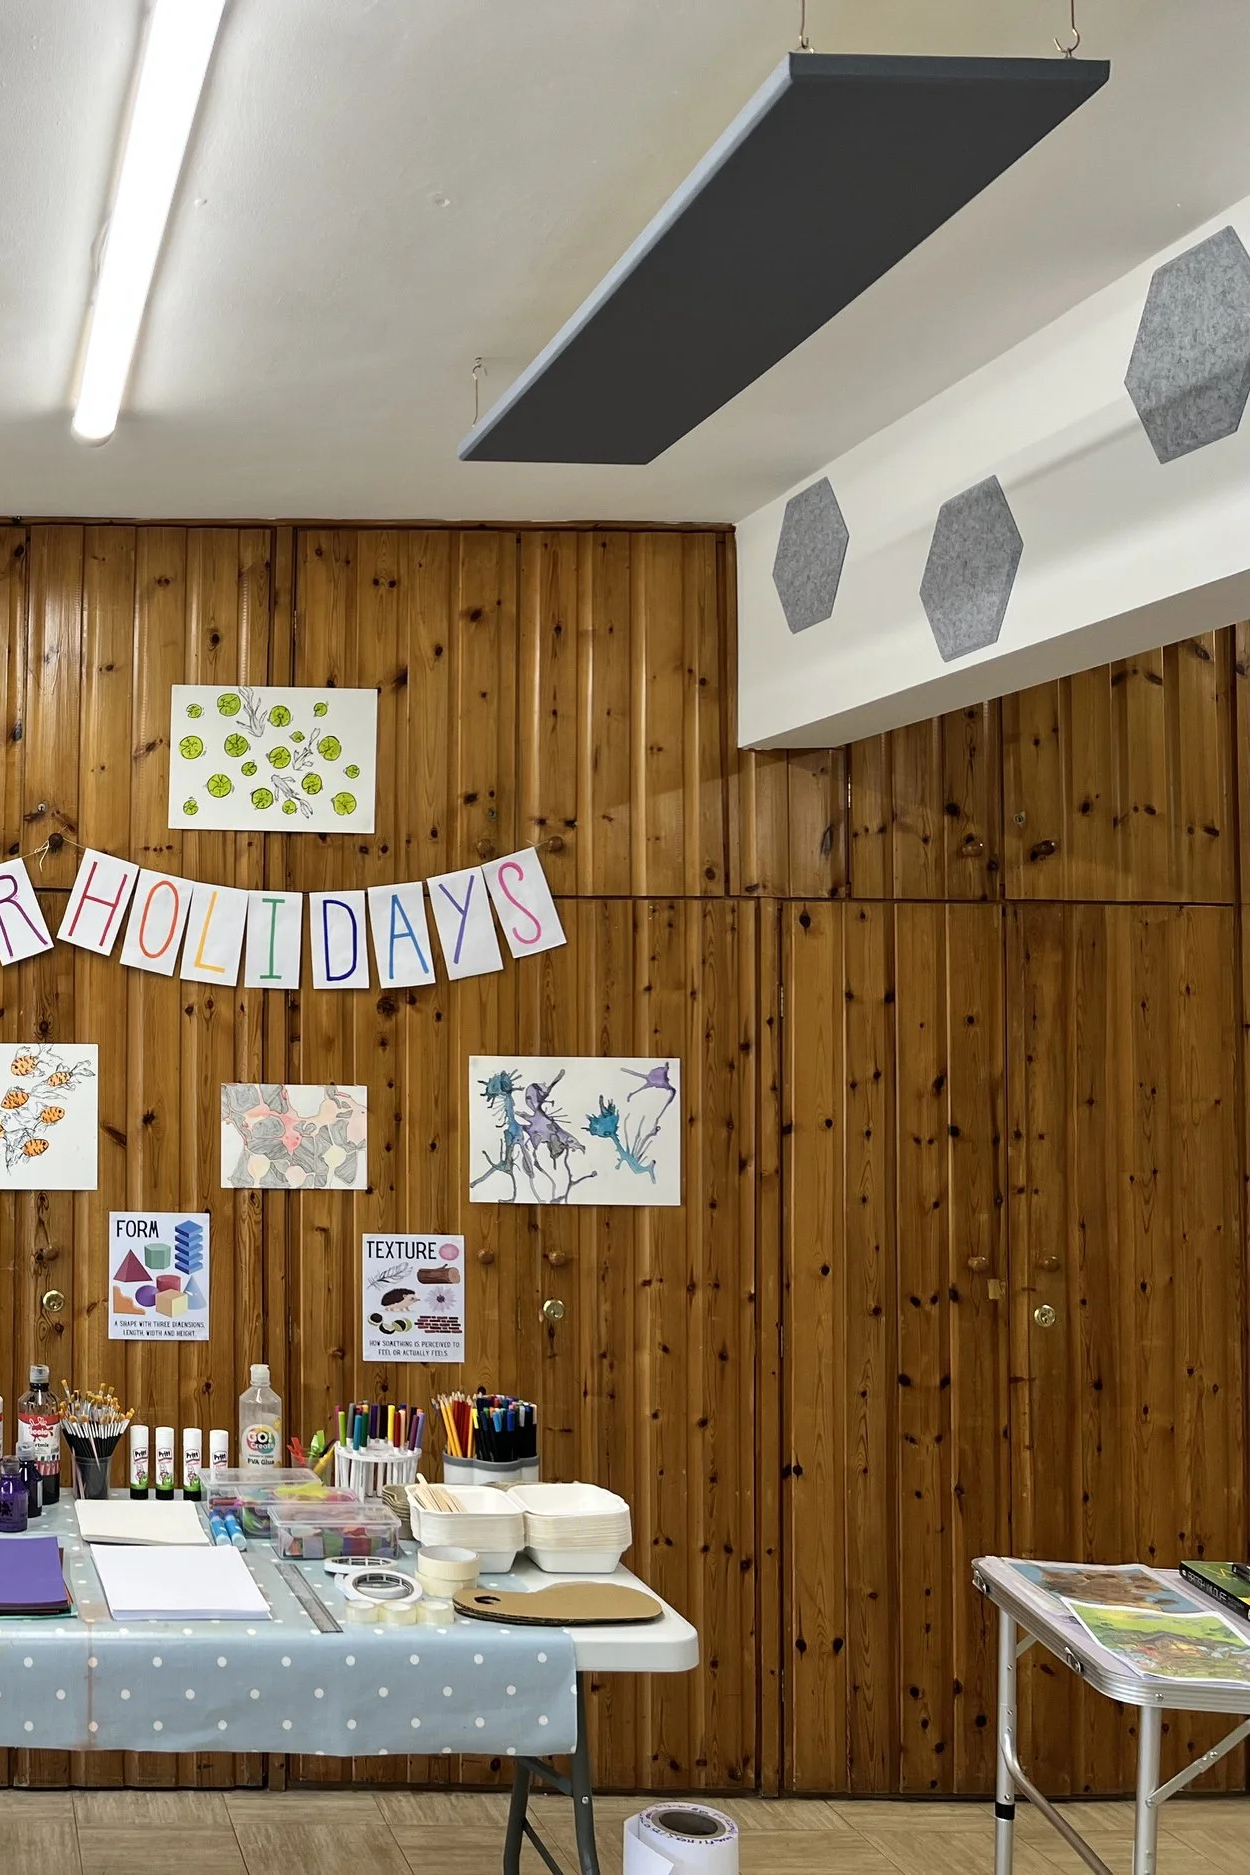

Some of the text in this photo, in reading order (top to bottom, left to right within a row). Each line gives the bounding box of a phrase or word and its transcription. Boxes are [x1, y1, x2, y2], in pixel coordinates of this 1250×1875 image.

[68, 861, 542, 982] HOLIDAYS
[116, 1220, 159, 1238] FORM
[367, 1240, 437, 1260] TEXTURE
[370, 1340, 460, 1348] HOW SOMETHING IS PERCEIVED TO
[378, 1349, 391, 1357] FEEL
[393, 1349, 401, 1357] OR
[402, 1349, 429, 1357] ACTUALLY
[247, 1430, 273, 1443] GO!
